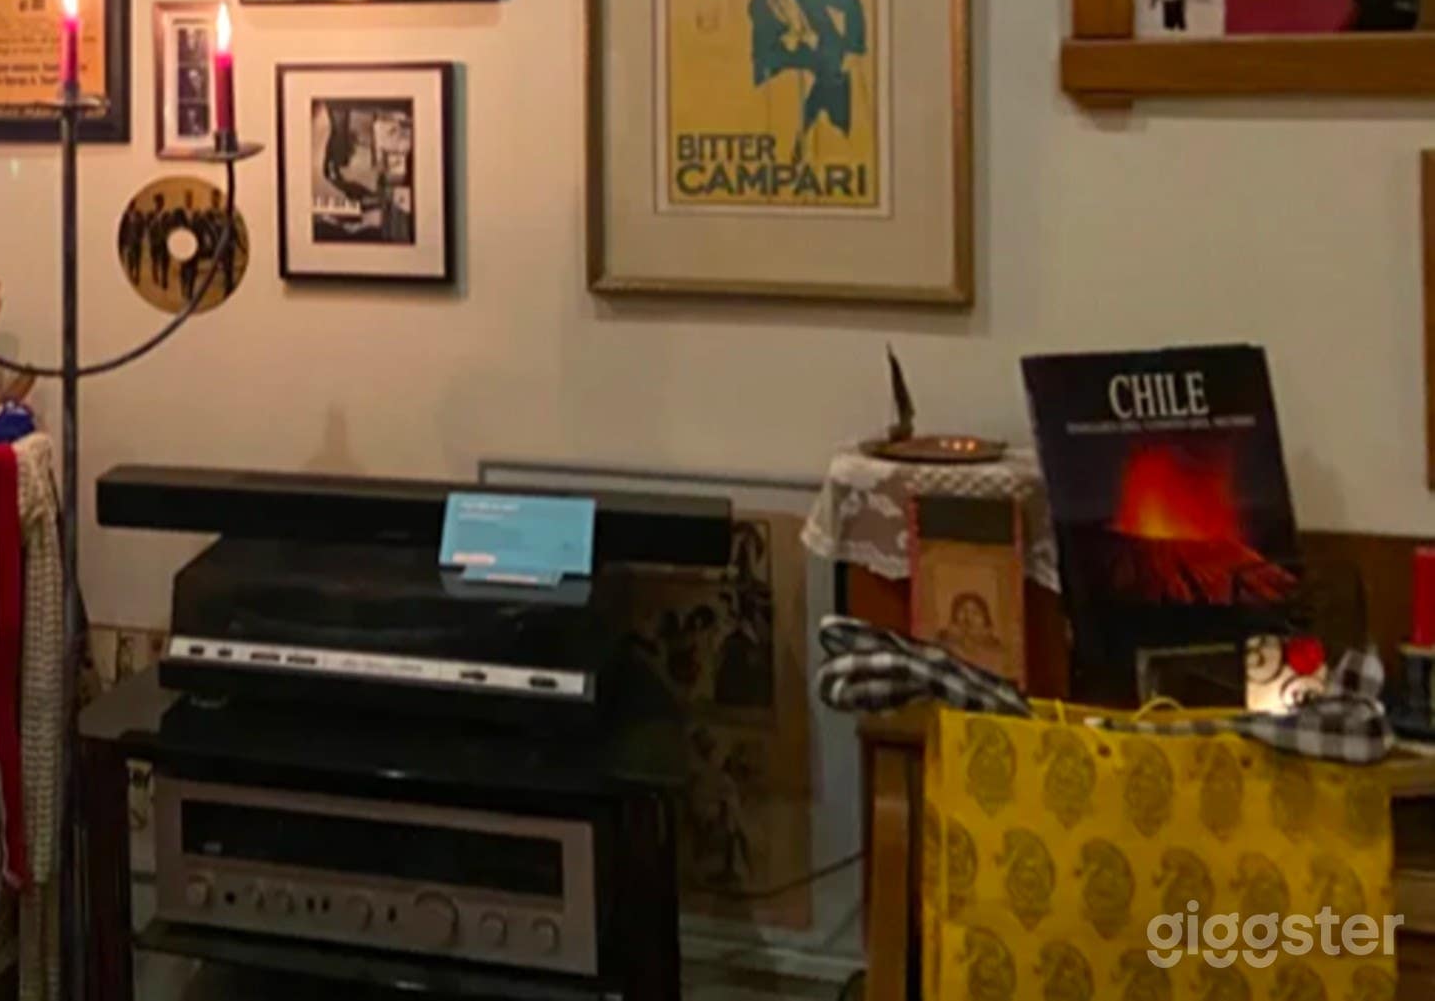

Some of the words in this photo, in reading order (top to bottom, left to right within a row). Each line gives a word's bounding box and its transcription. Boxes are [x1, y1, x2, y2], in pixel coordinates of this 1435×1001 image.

[676, 133, 777, 162] BITTER
[675, 162, 868, 197] CAMPARI
[1108, 371, 1210, 419] CHILE
